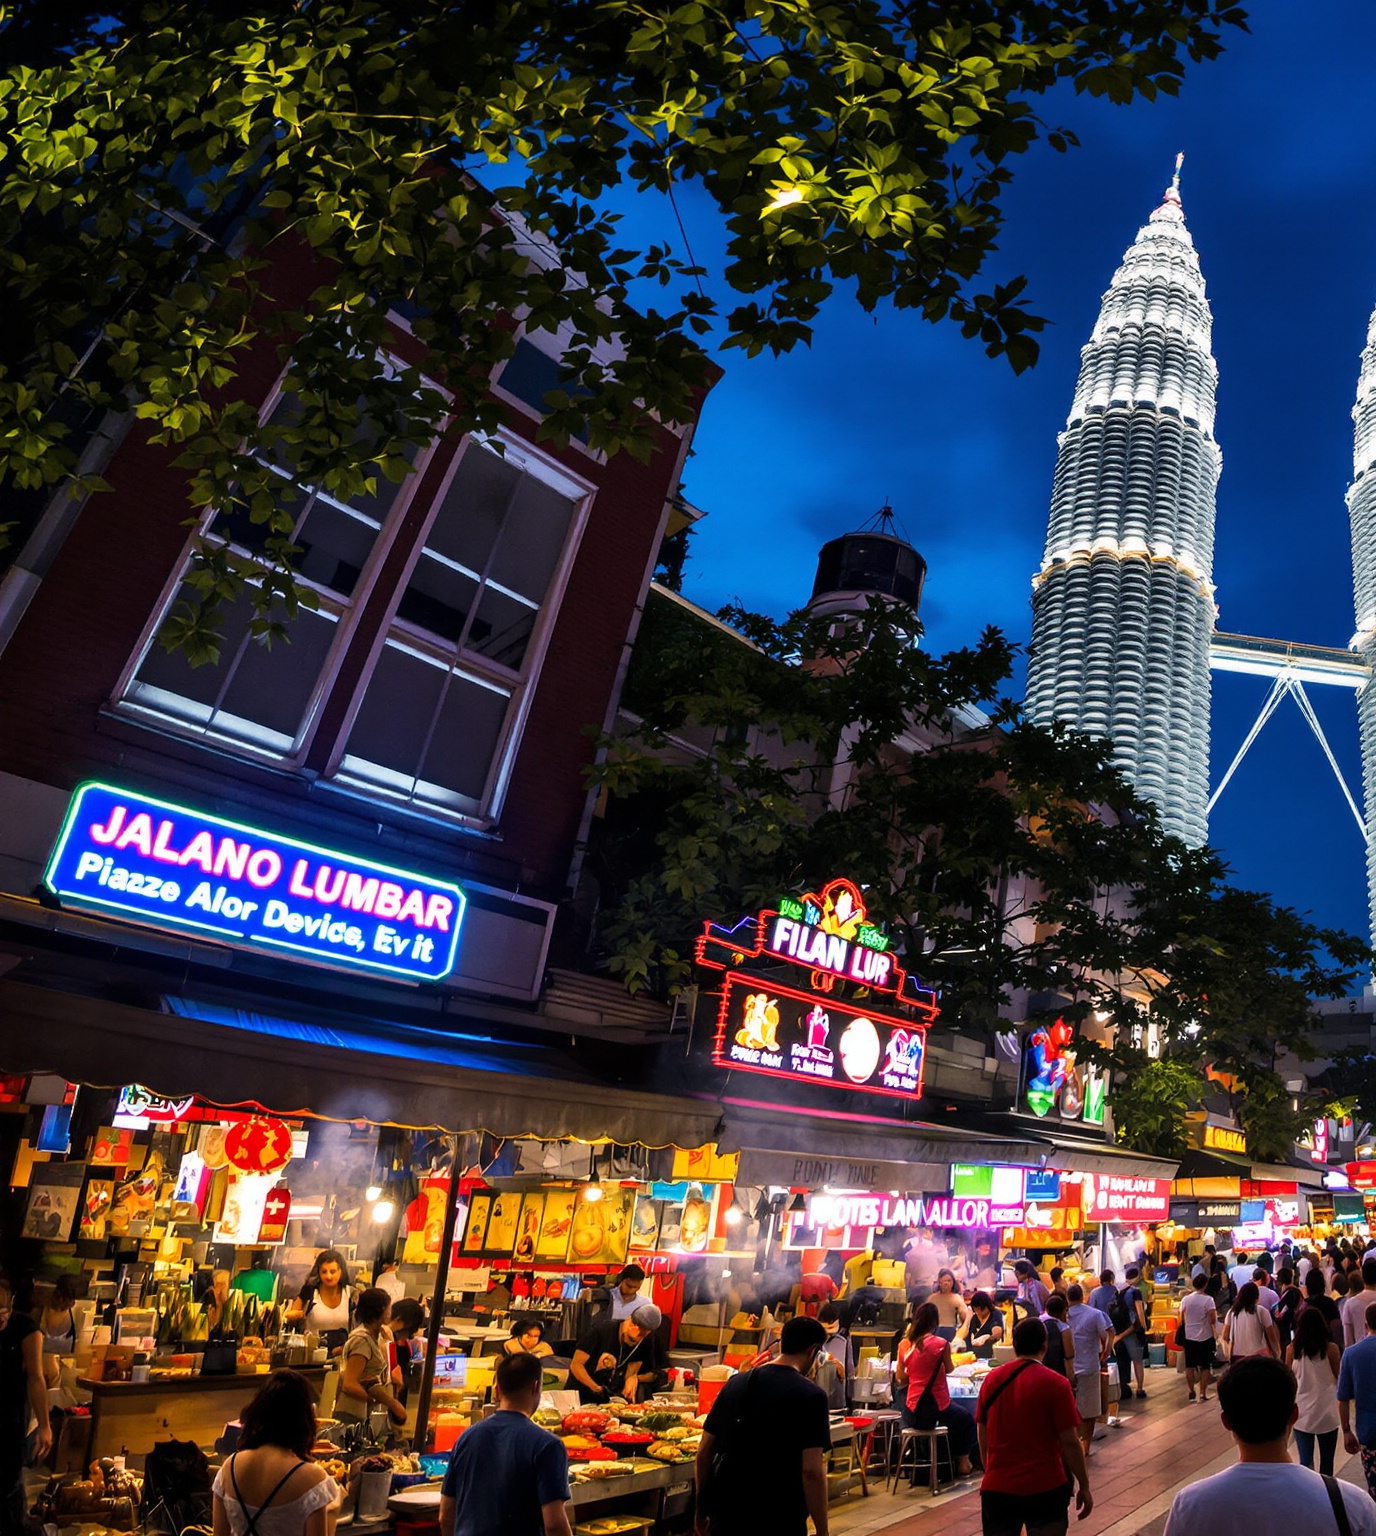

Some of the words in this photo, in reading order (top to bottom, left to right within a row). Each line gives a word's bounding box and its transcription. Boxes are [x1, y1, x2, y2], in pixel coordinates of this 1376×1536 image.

[90, 806, 282, 888] JALANO
[289, 860, 453, 931] LUMBAR
[186, 882, 257, 921] Alor
[772, 917, 848, 972] FILAN
[851, 946, 890, 985] LUR
